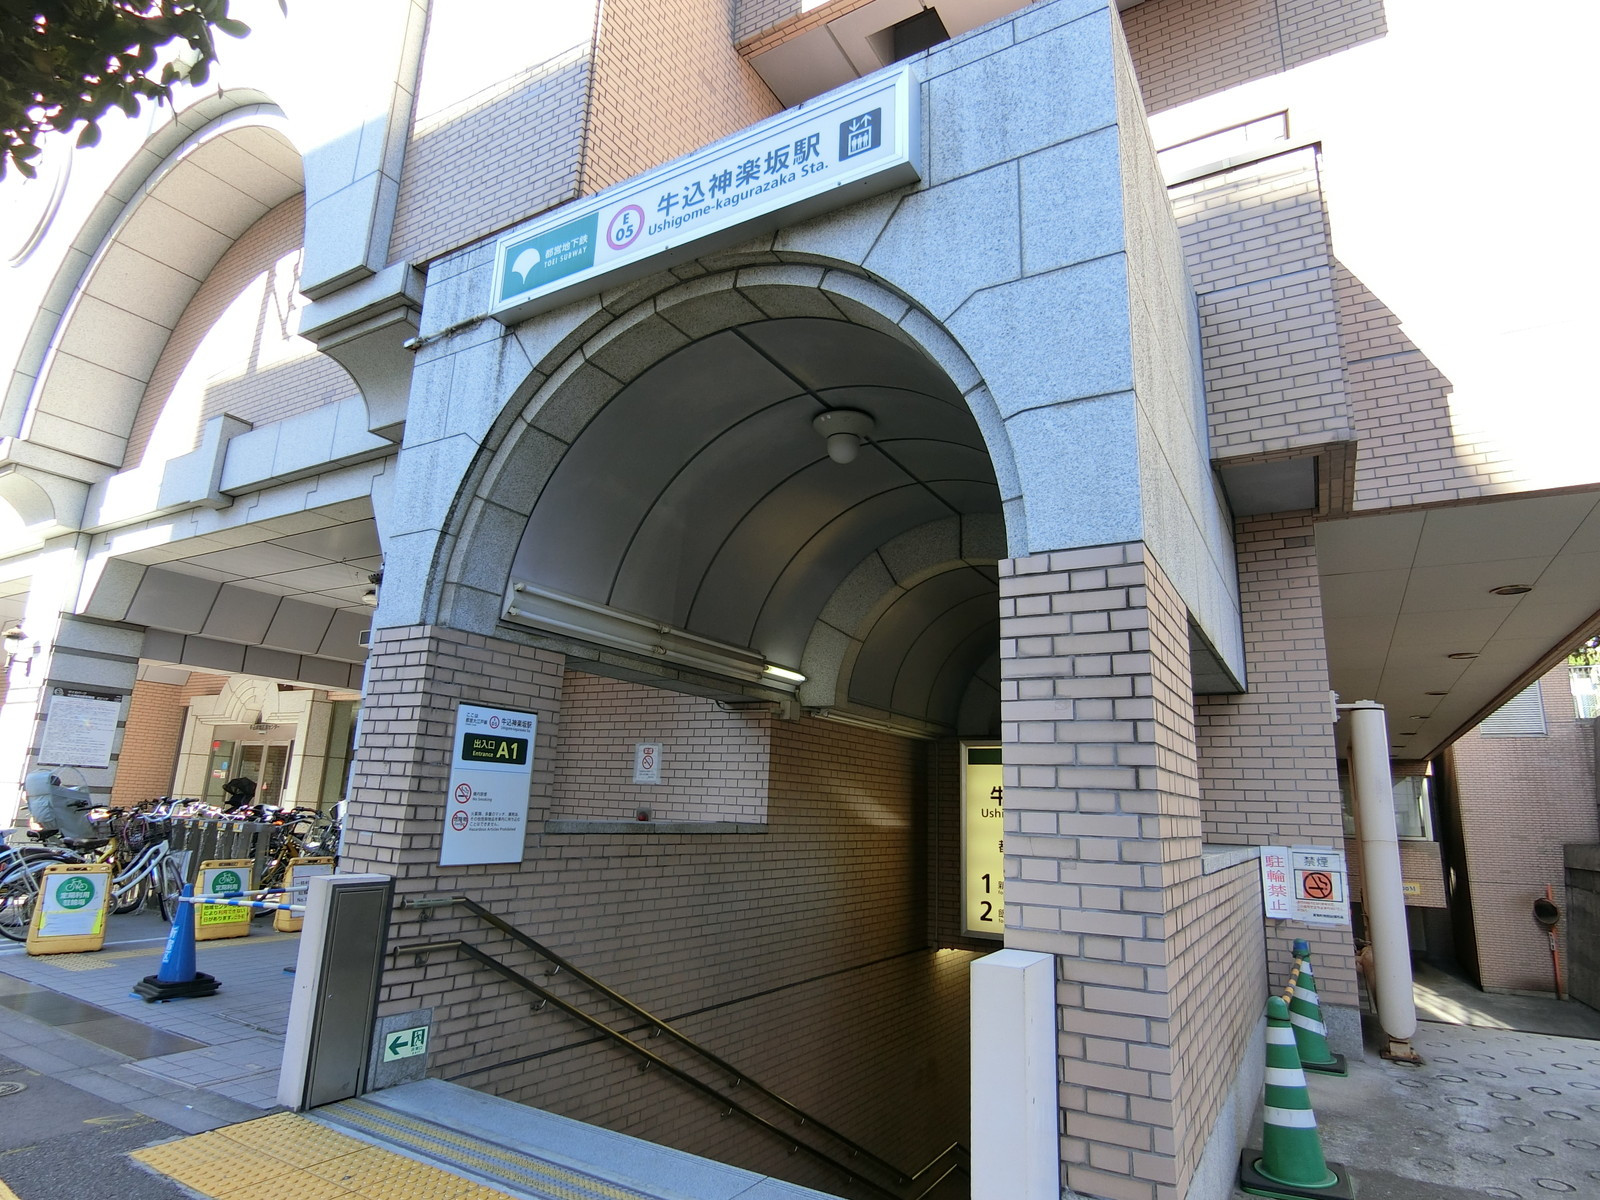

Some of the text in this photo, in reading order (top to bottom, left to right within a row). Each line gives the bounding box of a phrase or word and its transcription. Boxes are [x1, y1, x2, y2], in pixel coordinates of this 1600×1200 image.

[656, 132, 821, 218] 牛込神楽坂駅
[648, 160, 828, 236] Ushigome-kagurazaka Sta.
[622, 212, 630, 226] E
[615, 228, 634, 242] 05
[545, 233, 589, 259] 都営地下鉄
[544, 246, 588, 269] TOEI SUBWAY
[473, 739, 496, 750] 出入口
[496, 741, 518, 760] A1
[472, 750, 494, 758] Entrance
[1303, 856, 1329, 867] 禁煙
[215, 883, 239, 891] 定期利用
[981, 873, 990, 894] 1
[1265, 855, 1288, 912] 駐輪禁止
[61, 891, 90, 899] 定期利用
[63, 899, 86, 907] 駐輪場
[203, 908, 246, 916] により利用できない
[980, 901, 993, 922] 2
